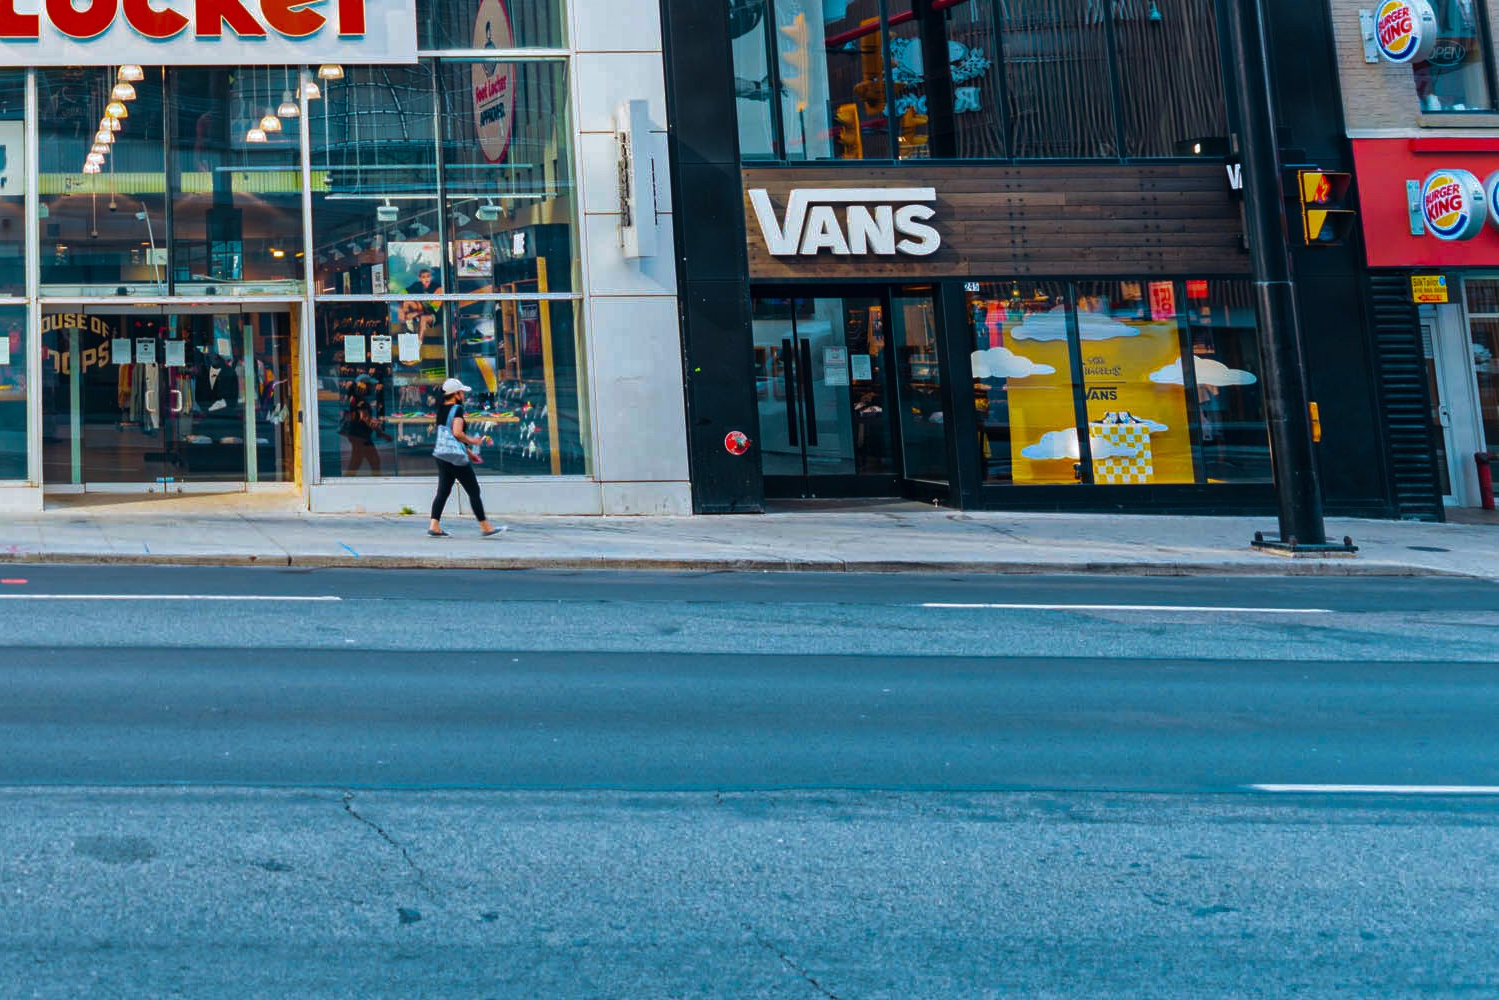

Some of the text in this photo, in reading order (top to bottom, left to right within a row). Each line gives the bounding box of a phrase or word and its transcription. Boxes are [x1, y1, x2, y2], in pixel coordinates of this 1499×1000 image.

[1378, 7, 1409, 34] BURGER
[1382, 18, 1413, 48] KING
[1426, 184, 1460, 207] BURGER
[1428, 195, 1462, 222] KING
[748, 187, 941, 256] VANS
[42, 313, 110, 337] OUSE OF
[47, 341, 109, 374] OOPS
